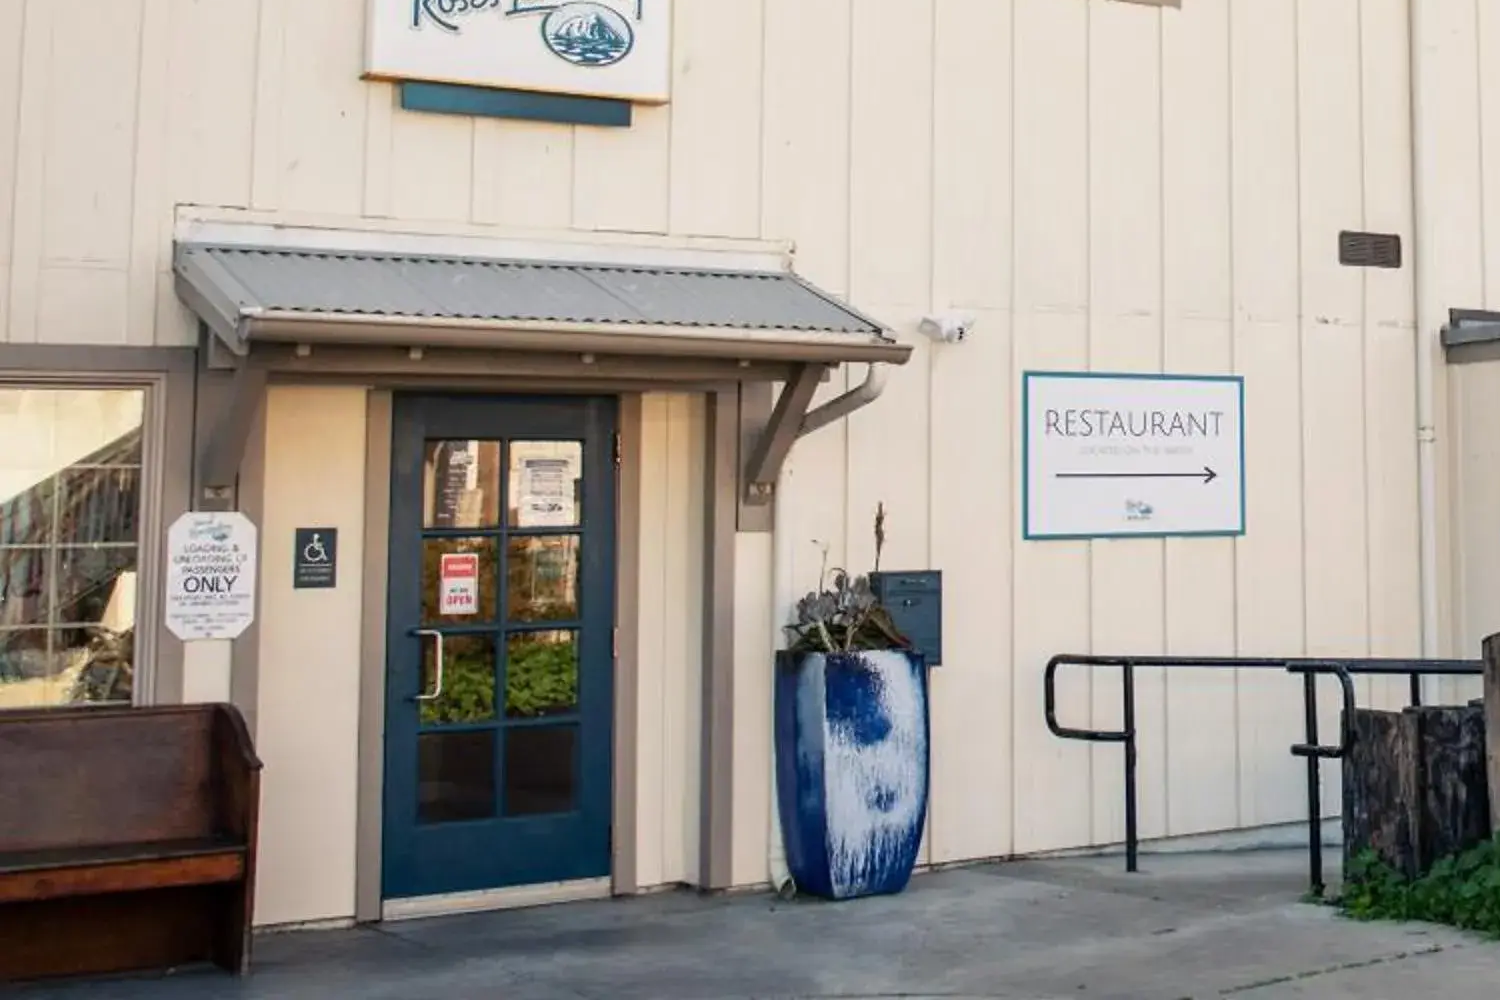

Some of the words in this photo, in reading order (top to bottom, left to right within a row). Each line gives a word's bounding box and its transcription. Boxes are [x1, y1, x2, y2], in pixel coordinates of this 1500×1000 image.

[1045, 409, 1223, 437] RESTAURANT
[184, 542, 229, 553] LOADING
[173, 553, 232, 564] UNLOADING
[181, 564, 241, 575] PASSENGERS
[183, 575, 238, 593] ONLY
